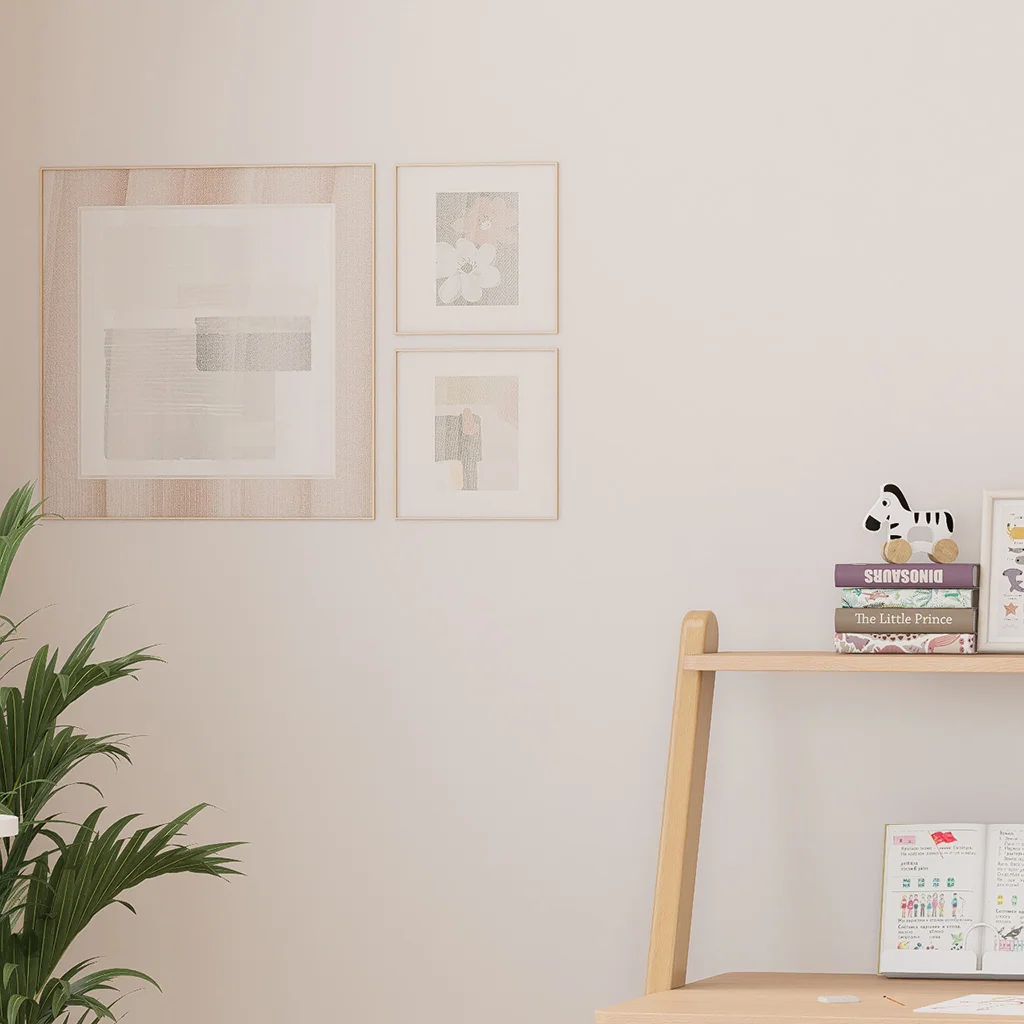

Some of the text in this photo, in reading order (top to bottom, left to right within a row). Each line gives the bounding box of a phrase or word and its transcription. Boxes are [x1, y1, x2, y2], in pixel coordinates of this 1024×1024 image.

[864, 569, 944, 584] DINOSAURS
[855, 612, 953, 625] The Little Prince
